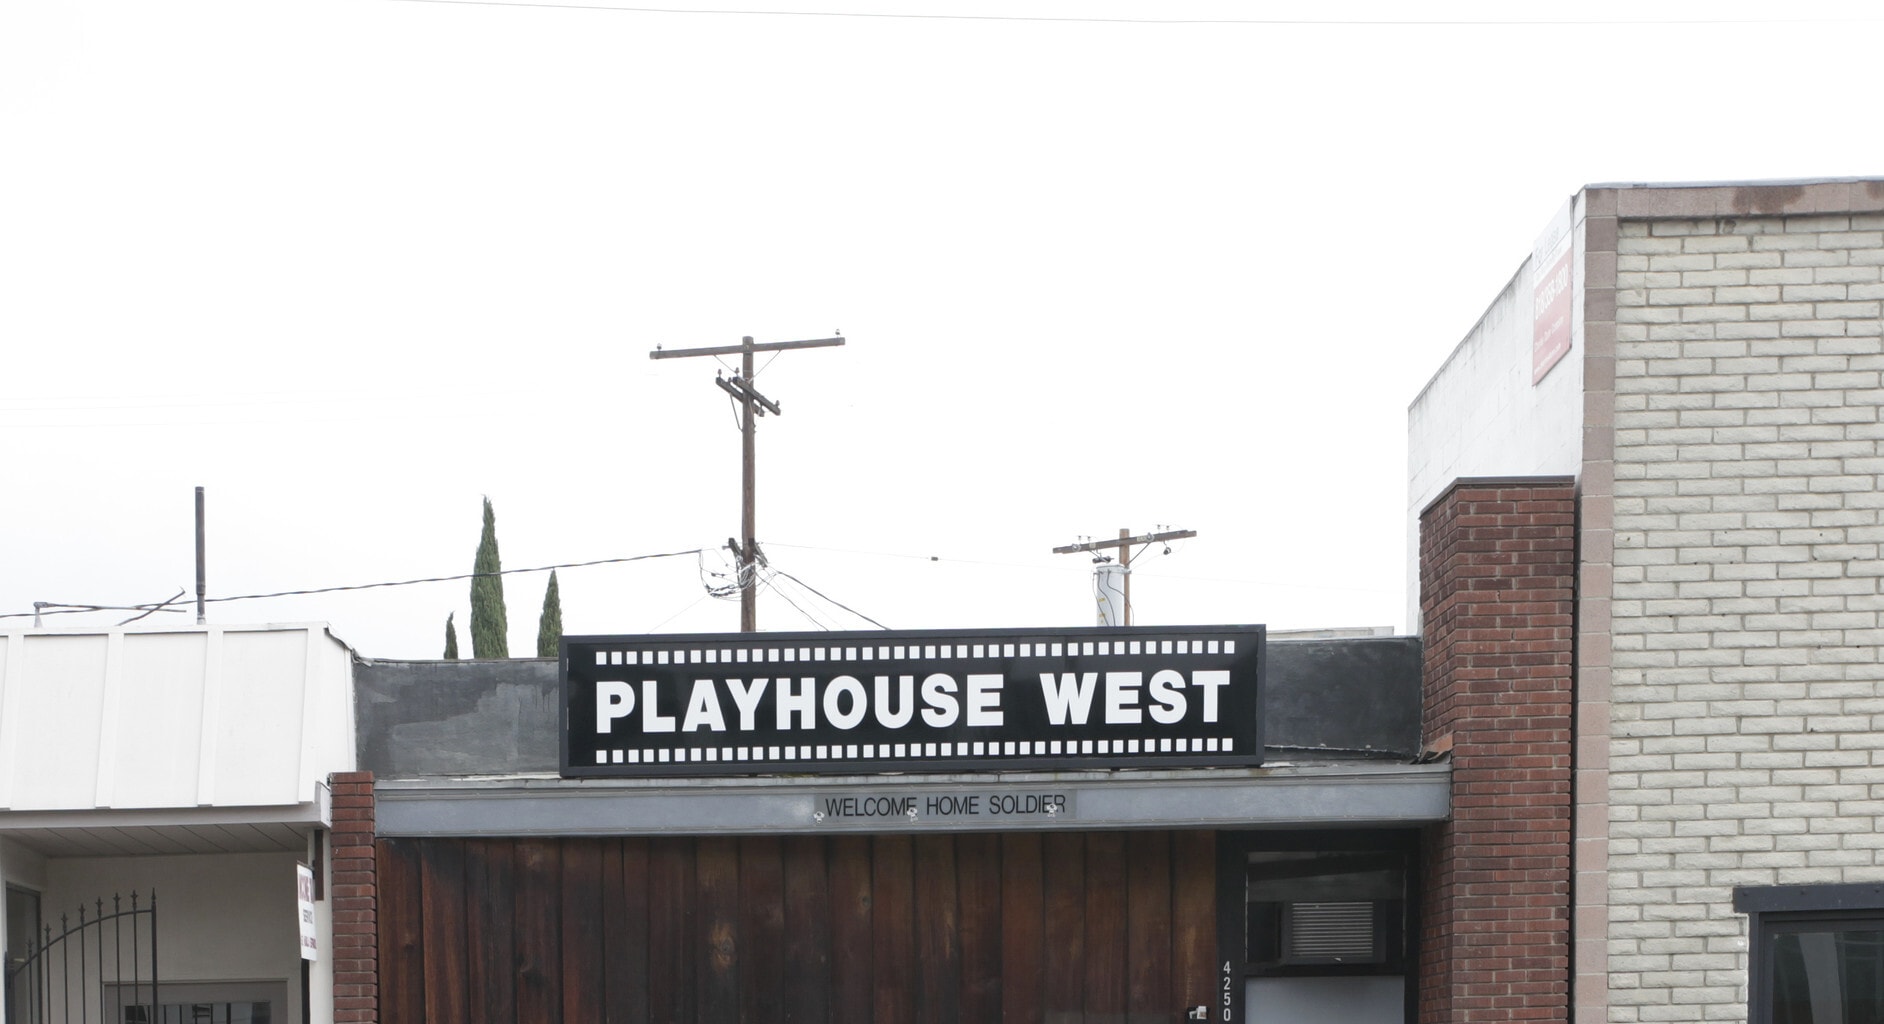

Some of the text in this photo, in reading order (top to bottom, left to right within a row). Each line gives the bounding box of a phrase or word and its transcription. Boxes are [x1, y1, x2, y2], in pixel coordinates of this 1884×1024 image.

[597, 670, 1230, 733] PLAYHOUSE WEST
[825, 794, 1066, 817] WELCOME HOME SOLDIER
[1223, 960, 1231, 1021] 4250
